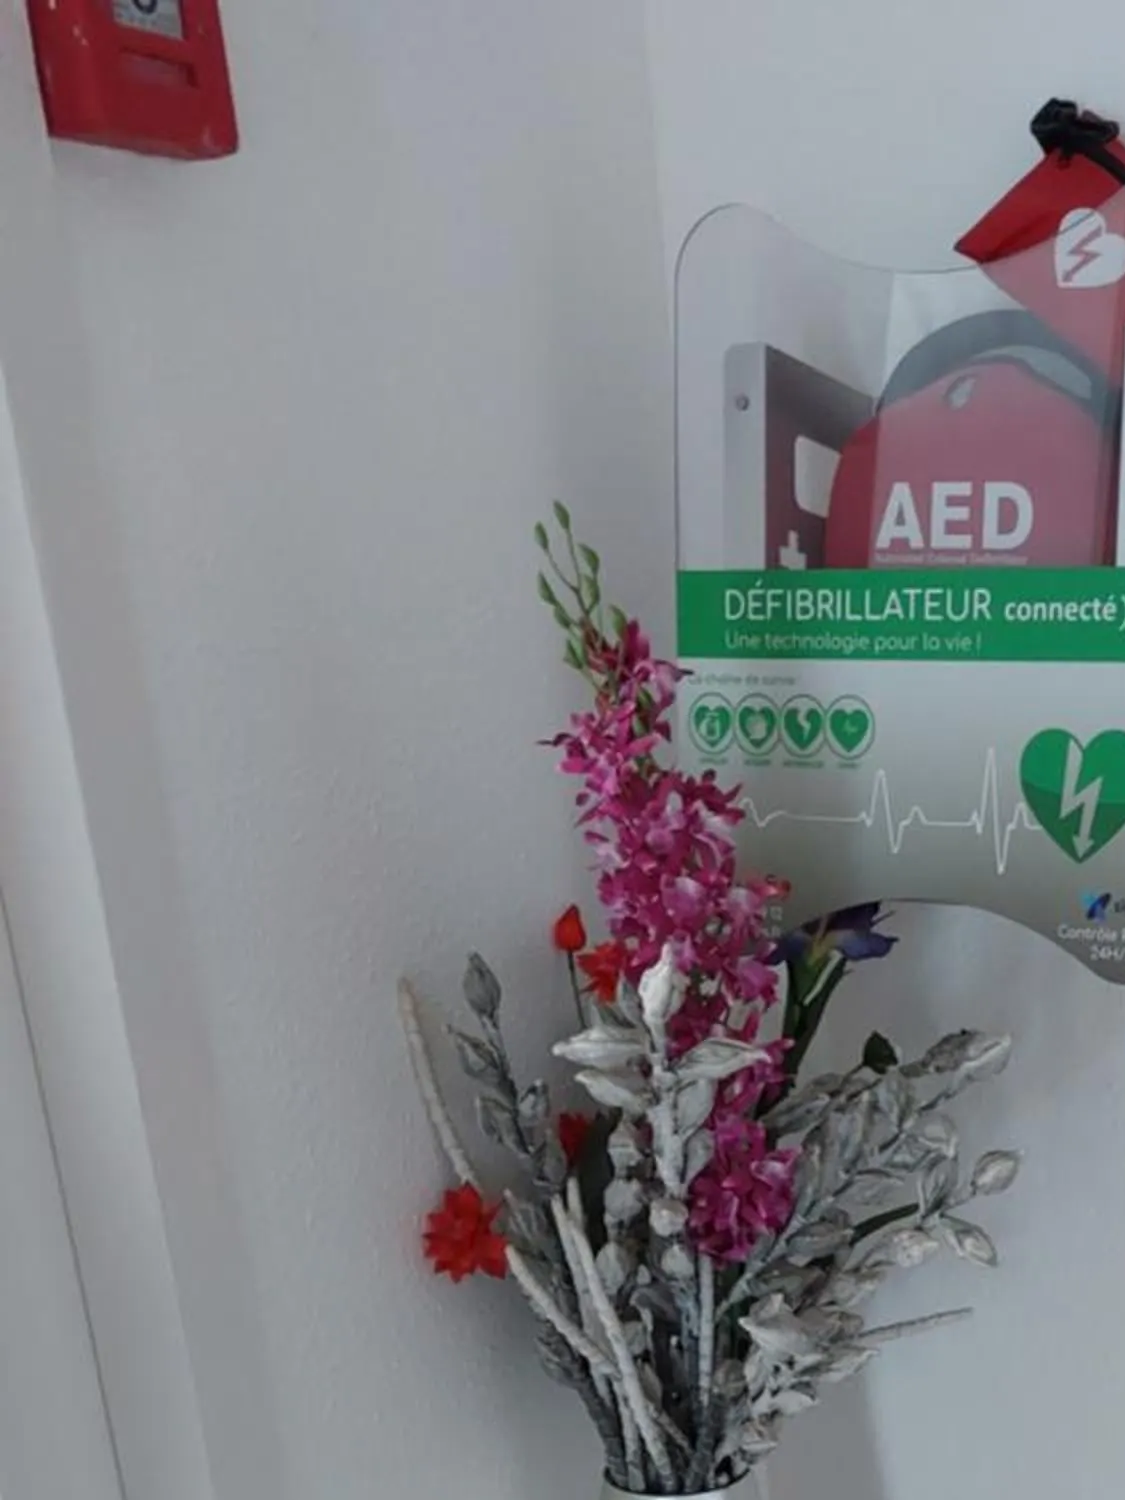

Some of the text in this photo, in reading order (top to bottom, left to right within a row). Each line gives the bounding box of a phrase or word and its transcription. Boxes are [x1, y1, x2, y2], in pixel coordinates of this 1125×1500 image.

[876, 481, 1033, 550] AED
[724, 580, 1117, 622] DÉFIBRILLATEUR connecté
[724, 631, 760, 650] Une
[764, 631, 870, 654] technologie
[874, 635, 918, 654] pour
[923, 633, 940, 651] la
[944, 633, 973, 651] vie
